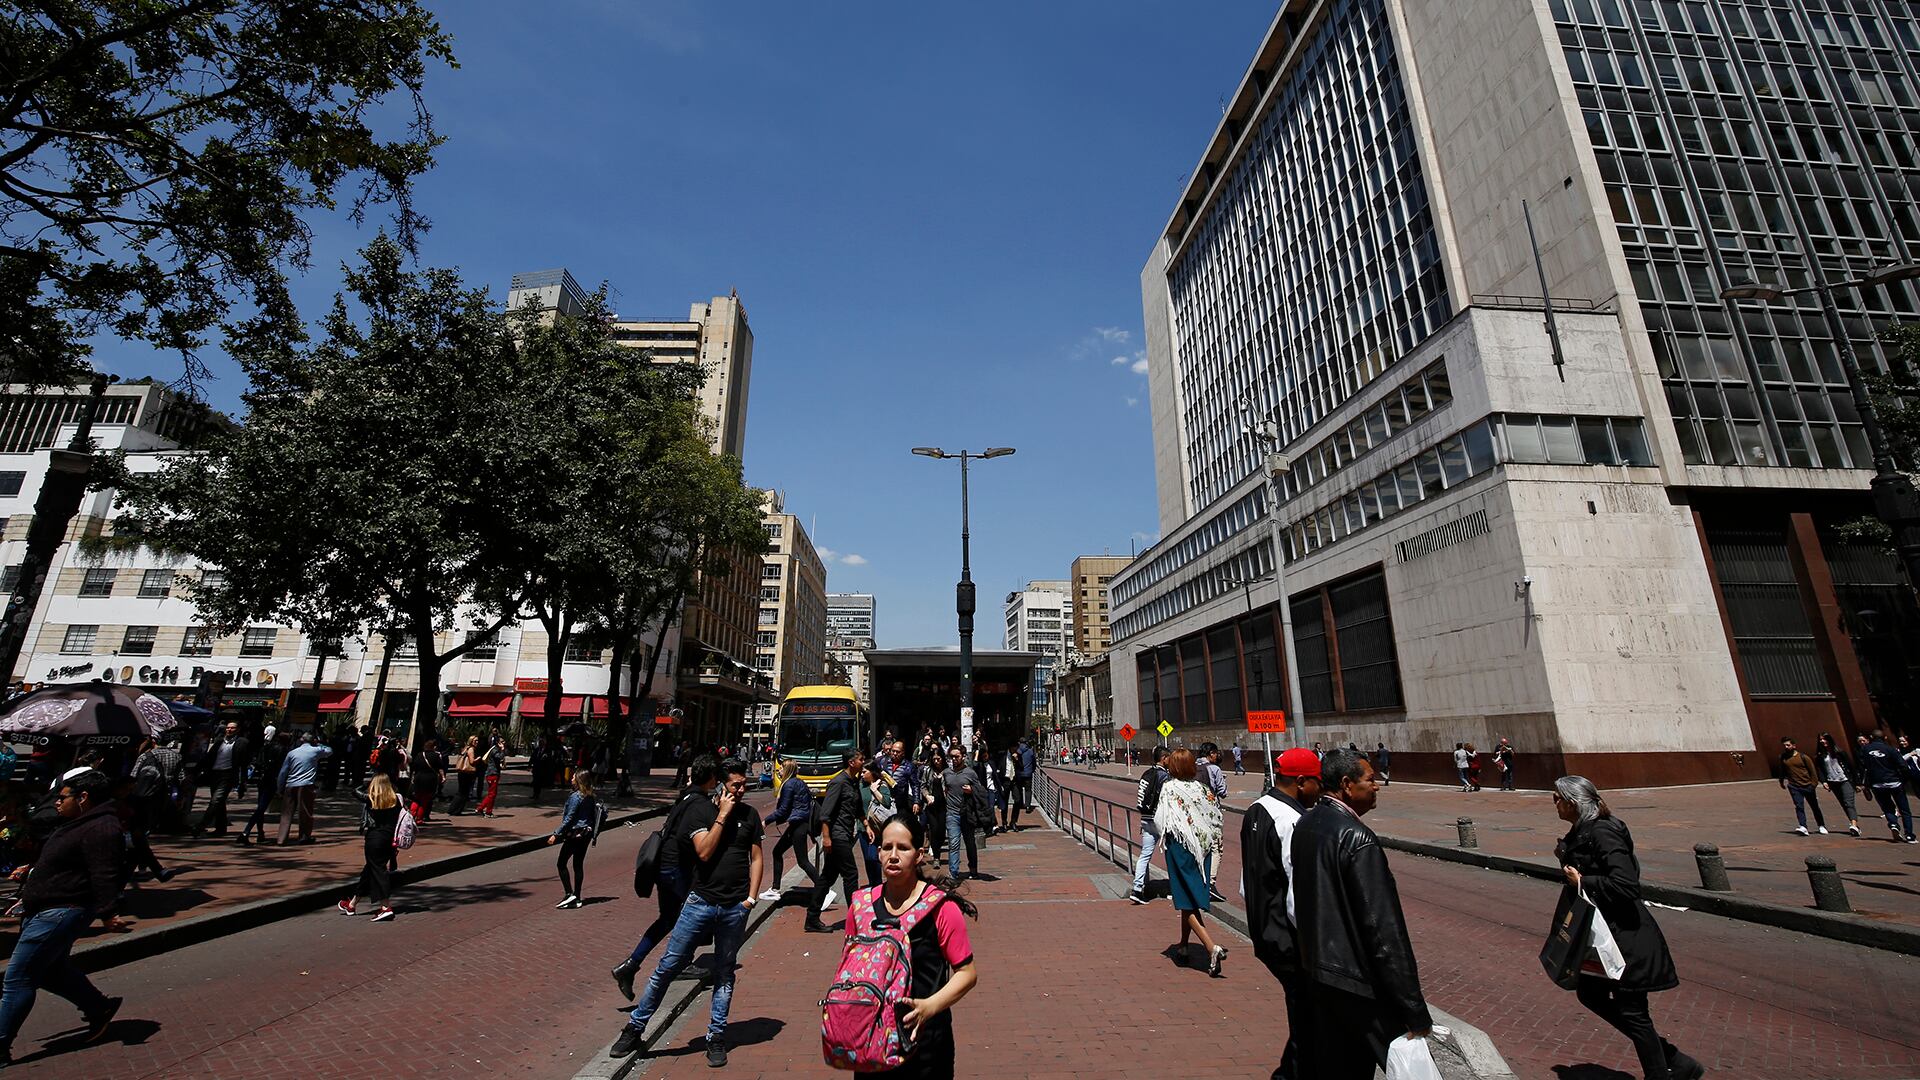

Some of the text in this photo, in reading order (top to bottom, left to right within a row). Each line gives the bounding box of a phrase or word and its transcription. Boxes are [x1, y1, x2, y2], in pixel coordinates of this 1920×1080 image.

[139, 665, 251, 685] Café Paje
[11, 732, 49, 745] SEIKO
[86, 736, 130, 745] SEIKO
[1137, 779, 1149, 808] PUMA
